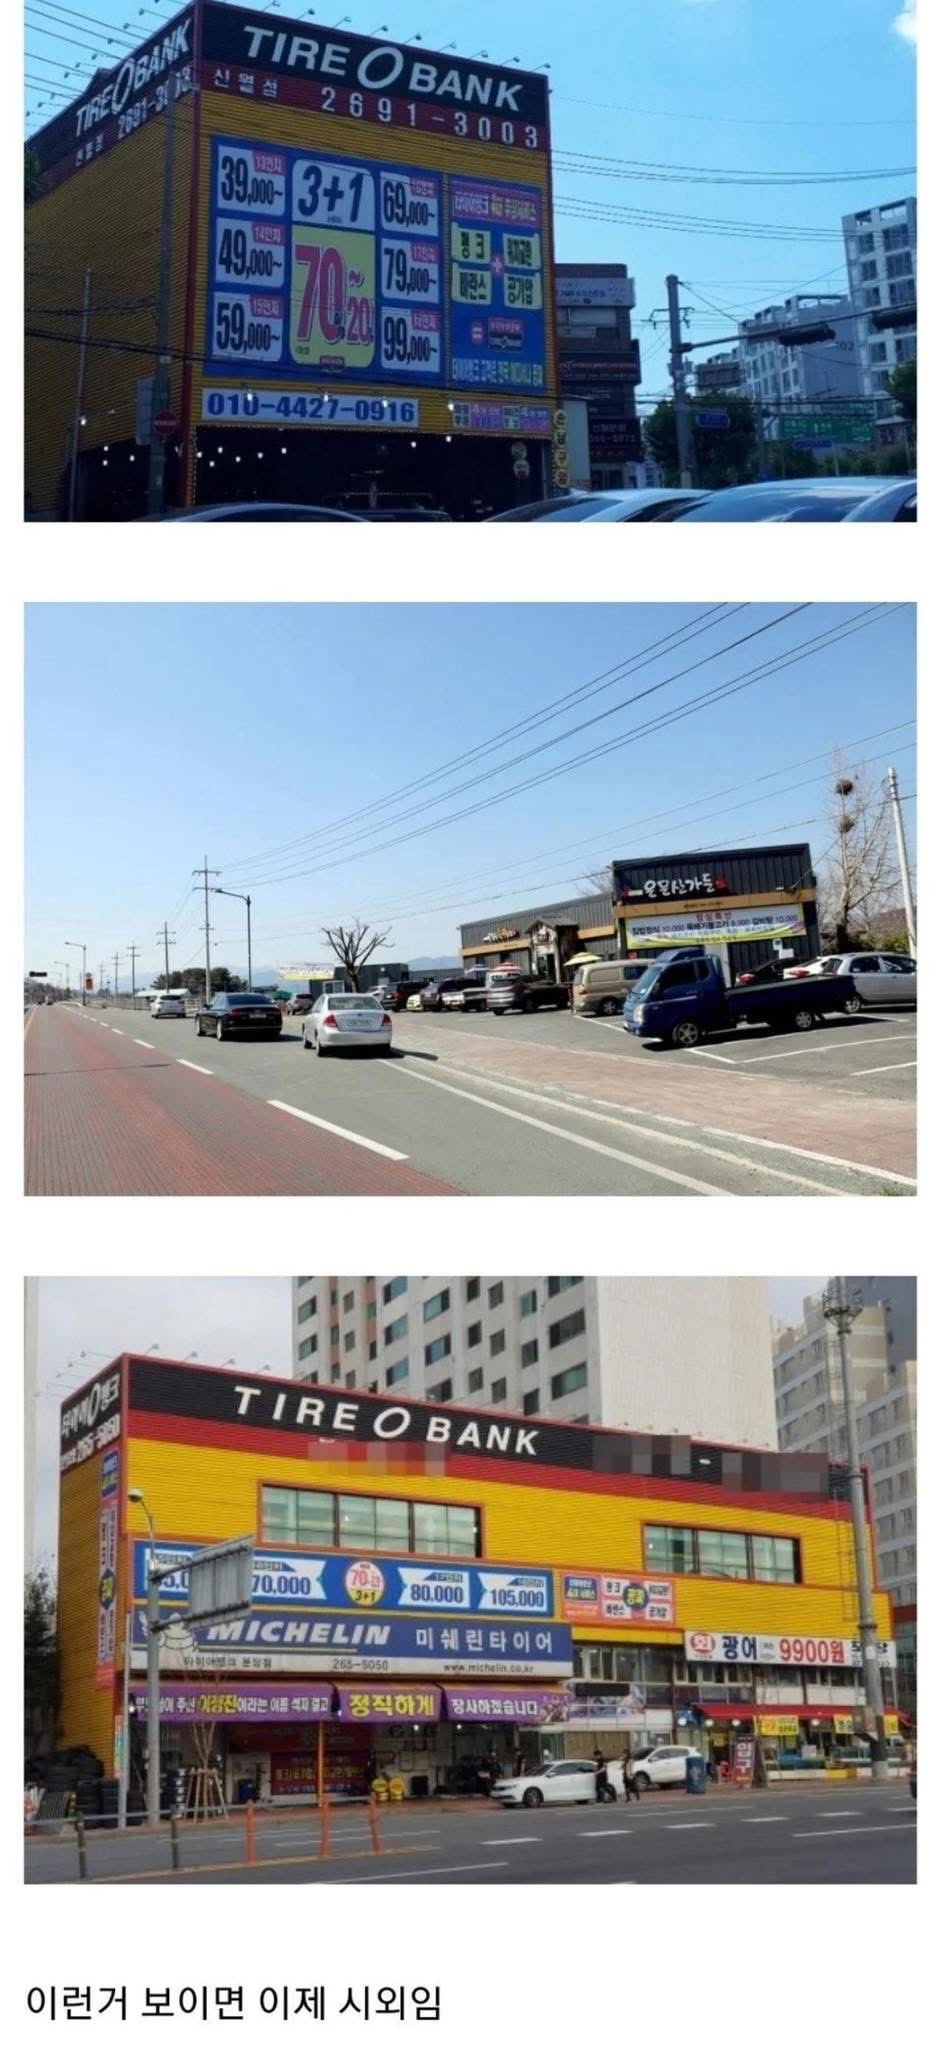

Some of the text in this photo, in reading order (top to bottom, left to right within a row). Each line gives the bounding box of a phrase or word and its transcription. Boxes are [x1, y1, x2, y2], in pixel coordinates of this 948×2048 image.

[76, 84, 114, 137] TIRE
[133, 19, 192, 92] BANK
[243, 25, 351, 76] TIRE
[408, 62, 523, 112] BANK
[320, 86, 538, 149] 2691-3003
[298, 164, 365, 223] 3+1
[207, 392, 416, 422] 010-4427-0916
[234, 1386, 360, 1431] TIRE
[426, 1416, 540, 1456] BANK
[252, 1574, 311, 1595] 70,000
[354, 1589, 377, 1603] 3+1
[411, 1583, 464, 1604] 80,000
[491, 1588, 545, 1607] 105,000
[206, 1618, 391, 1646] MICHELIN
[415, 1626, 553, 1654] 미쉐린타이어
[722, 1635, 758, 1661] 광어
[779, 1638, 845, 1664] 9900원
[332, 1658, 389, 1671] 265-5050
[443, 1662, 535, 1674] www.michelin.co.kr
[350, 1693, 435, 1717] 정직하게
[451, 1698, 539, 1716] 장사하겠습니다
